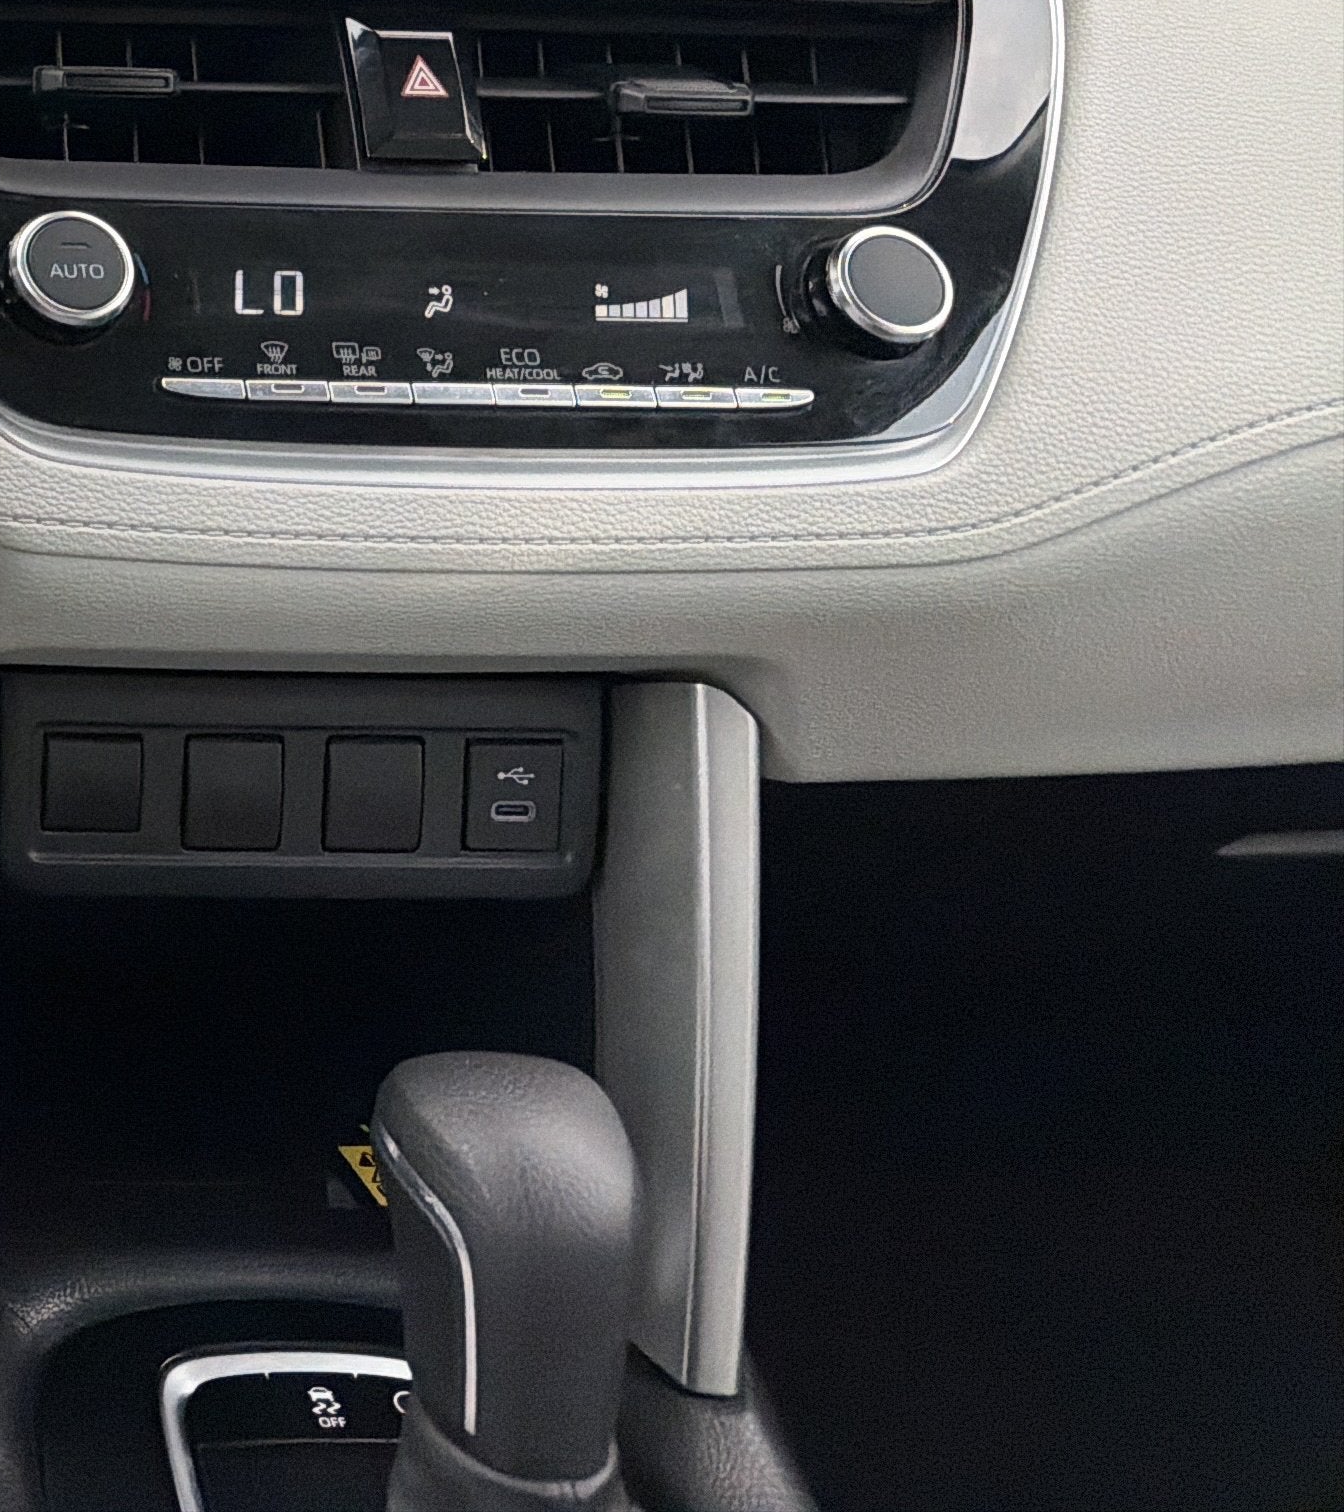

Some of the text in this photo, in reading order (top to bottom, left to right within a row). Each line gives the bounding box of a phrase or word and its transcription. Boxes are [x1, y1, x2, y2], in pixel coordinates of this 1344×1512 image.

[49, 263, 105, 281] AUTO
[234, 269, 304, 316] LO
[186, 356, 224, 373] OFF
[499, 348, 542, 366] ECO
[256, 363, 298, 376] FRONT
[342, 365, 377, 377] REAR
[486, 367, 562, 381] HEAT/COOL
[744, 364, 783, 385] A/C
[318, 1416, 347, 1429] OFF
